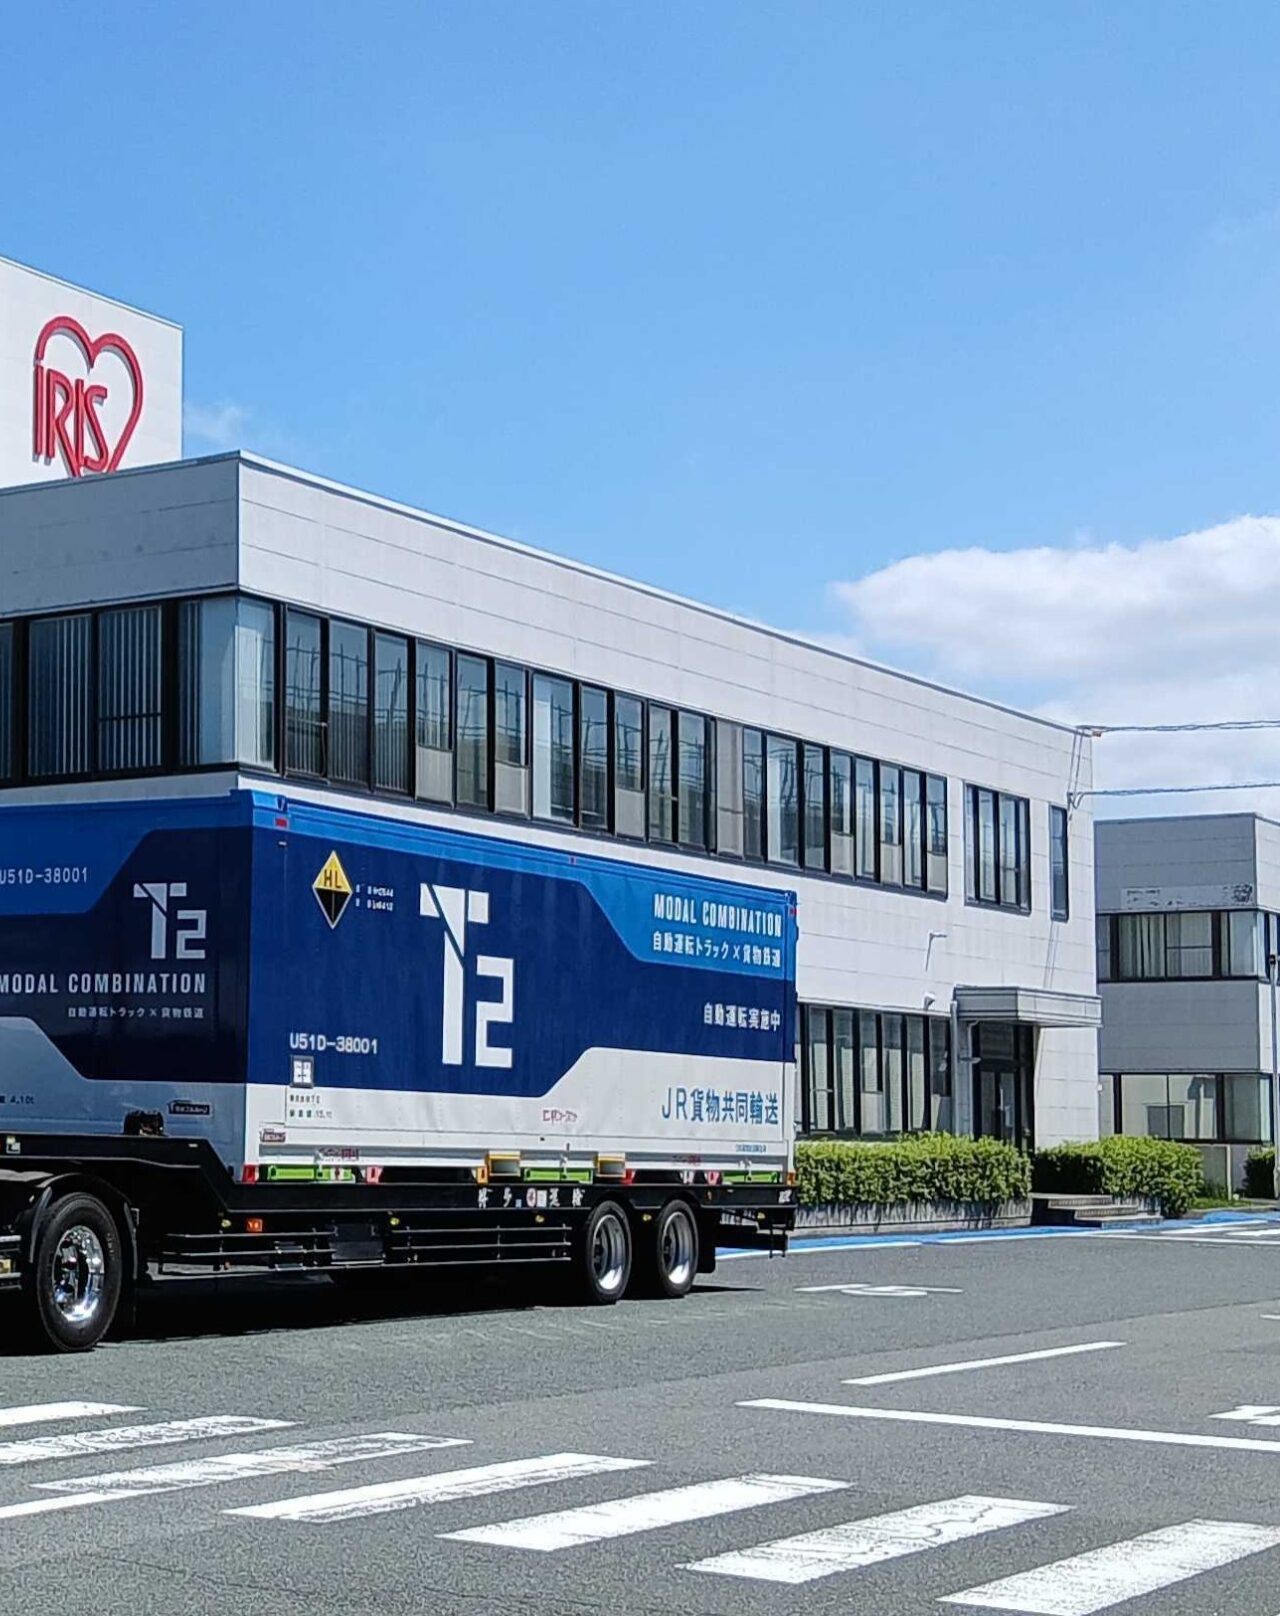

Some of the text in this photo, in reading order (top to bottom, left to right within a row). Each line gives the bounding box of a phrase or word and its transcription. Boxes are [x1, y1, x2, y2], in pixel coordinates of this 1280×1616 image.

[654, 893, 782, 938] MODAL COMBINATION
[68, 972, 206, 994] COMBINATION
[703, 1002, 781, 1032] 自動運転実施中
[289, 1032, 378, 1055] U51D-38001
